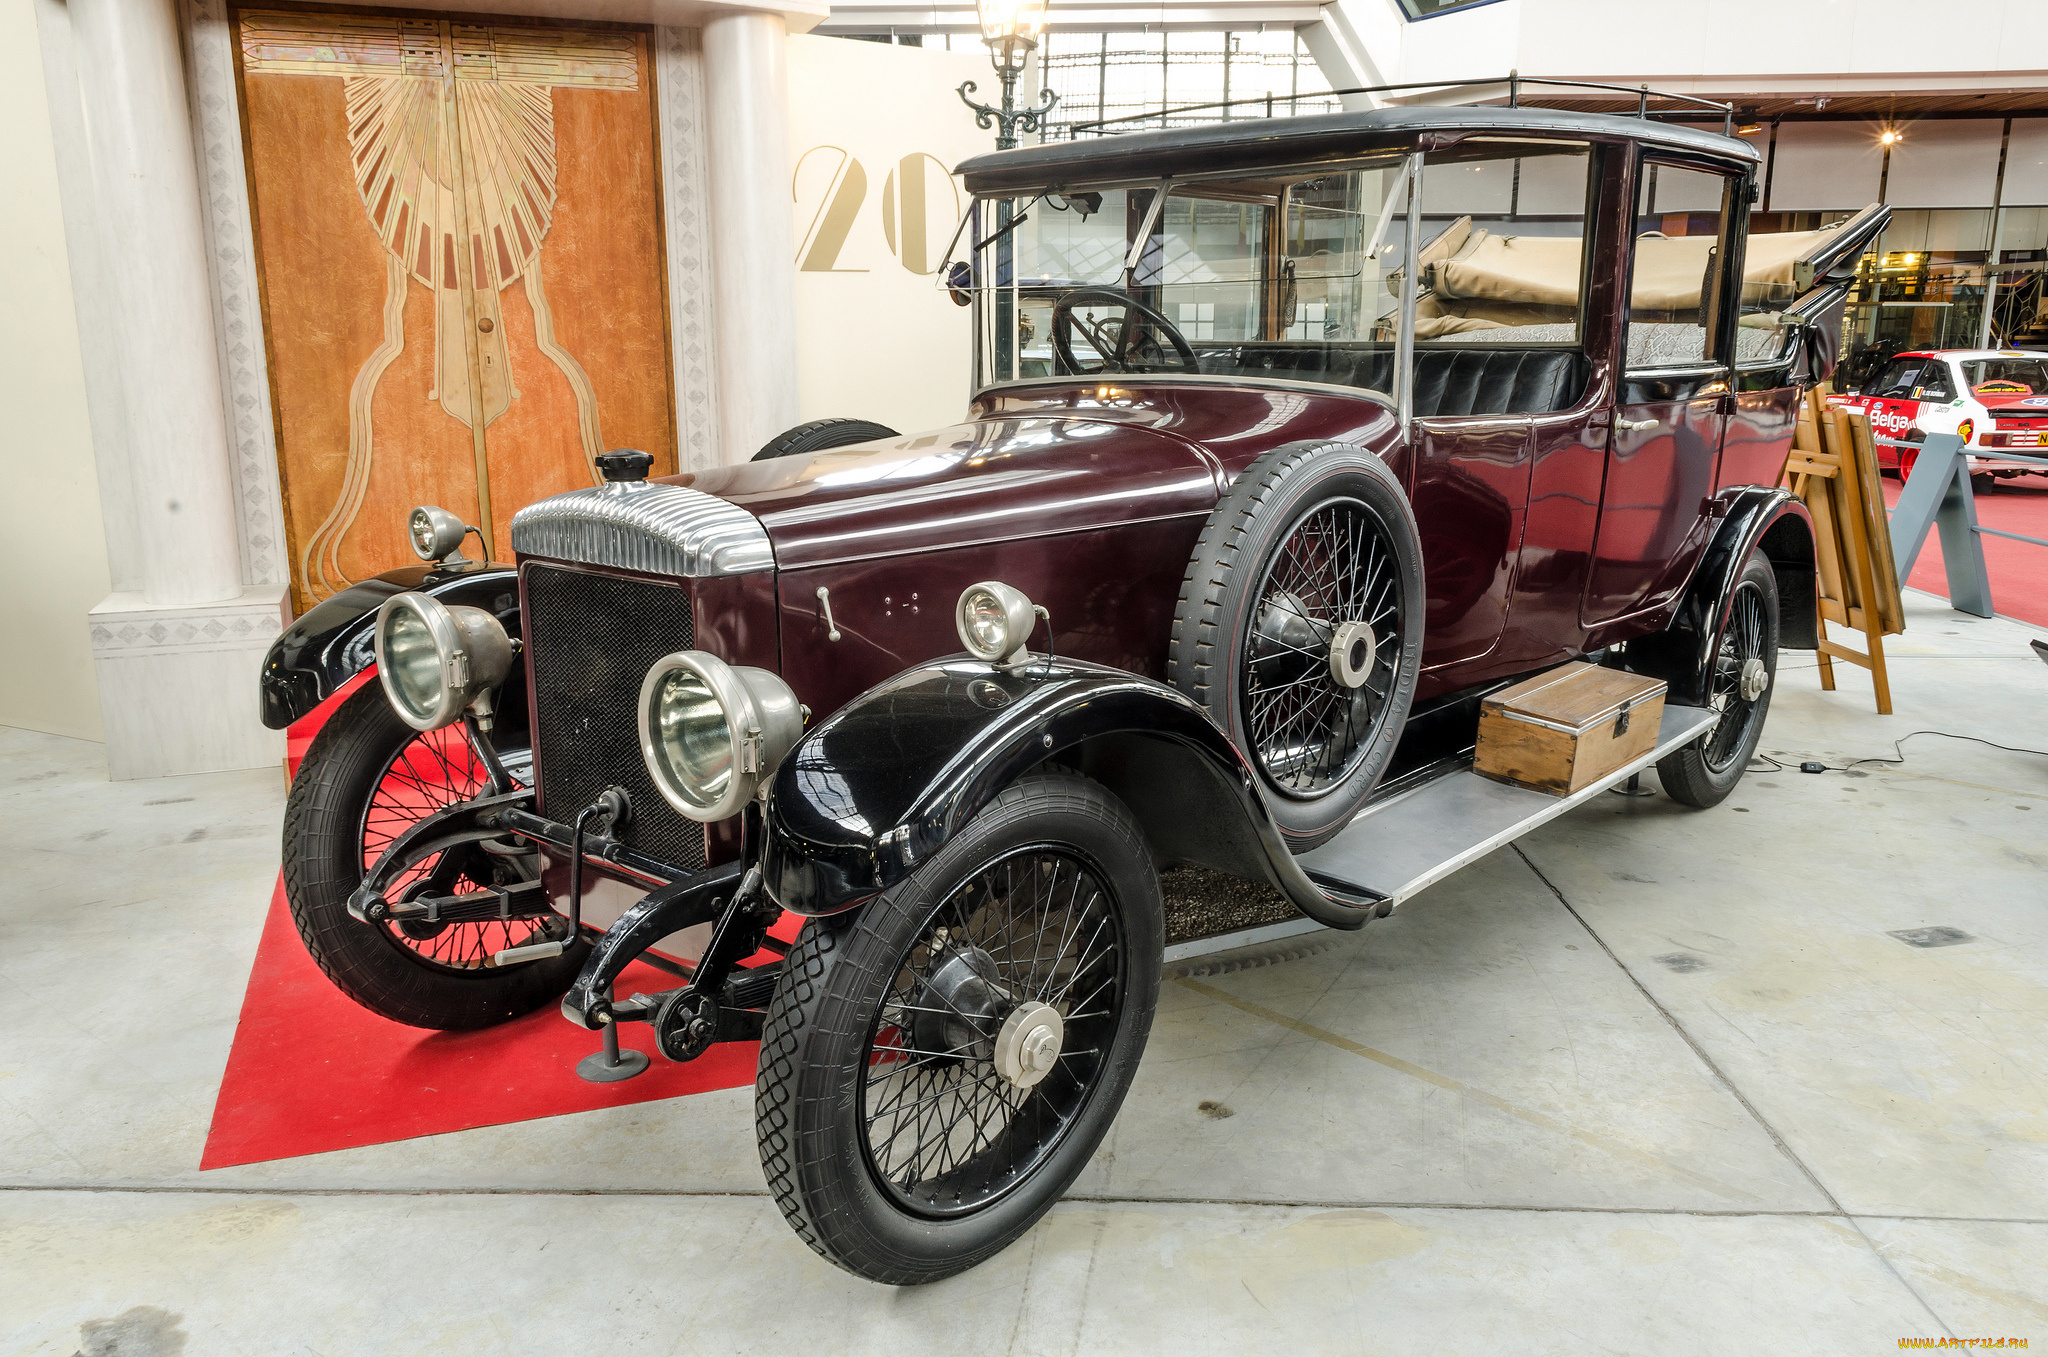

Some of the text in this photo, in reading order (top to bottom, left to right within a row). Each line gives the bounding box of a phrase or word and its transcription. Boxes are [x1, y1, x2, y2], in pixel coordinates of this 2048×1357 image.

[793, 145, 960, 276] 20
[1870, 409, 1909, 433] Belga
[1348, 642, 1418, 799] INDIA CORD
[335, 875, 436, 998] MICHELN
[837, 889, 935, 1111] MICHELIN
